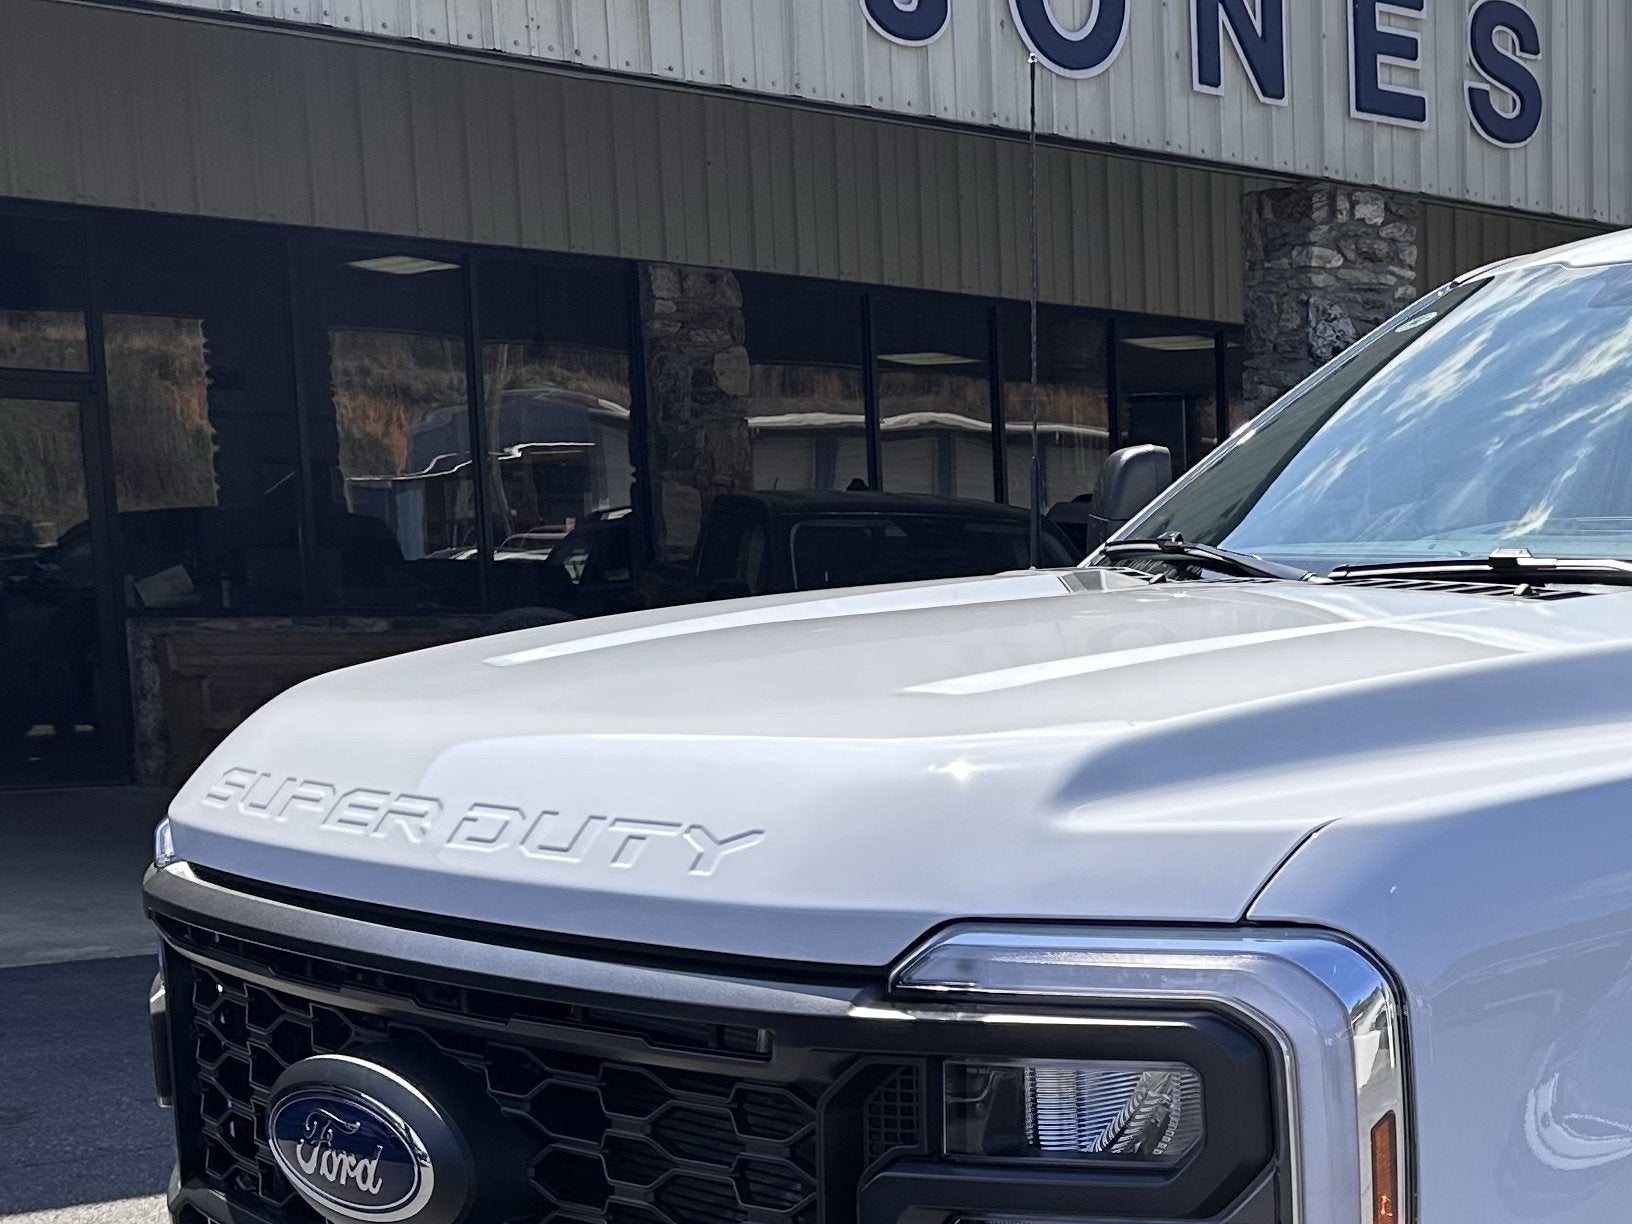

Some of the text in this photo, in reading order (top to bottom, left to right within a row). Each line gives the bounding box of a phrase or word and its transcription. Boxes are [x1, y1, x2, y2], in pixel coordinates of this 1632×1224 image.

[201, 766, 765, 877] SUPER DUTY
[296, 1108, 384, 1195] Ford
